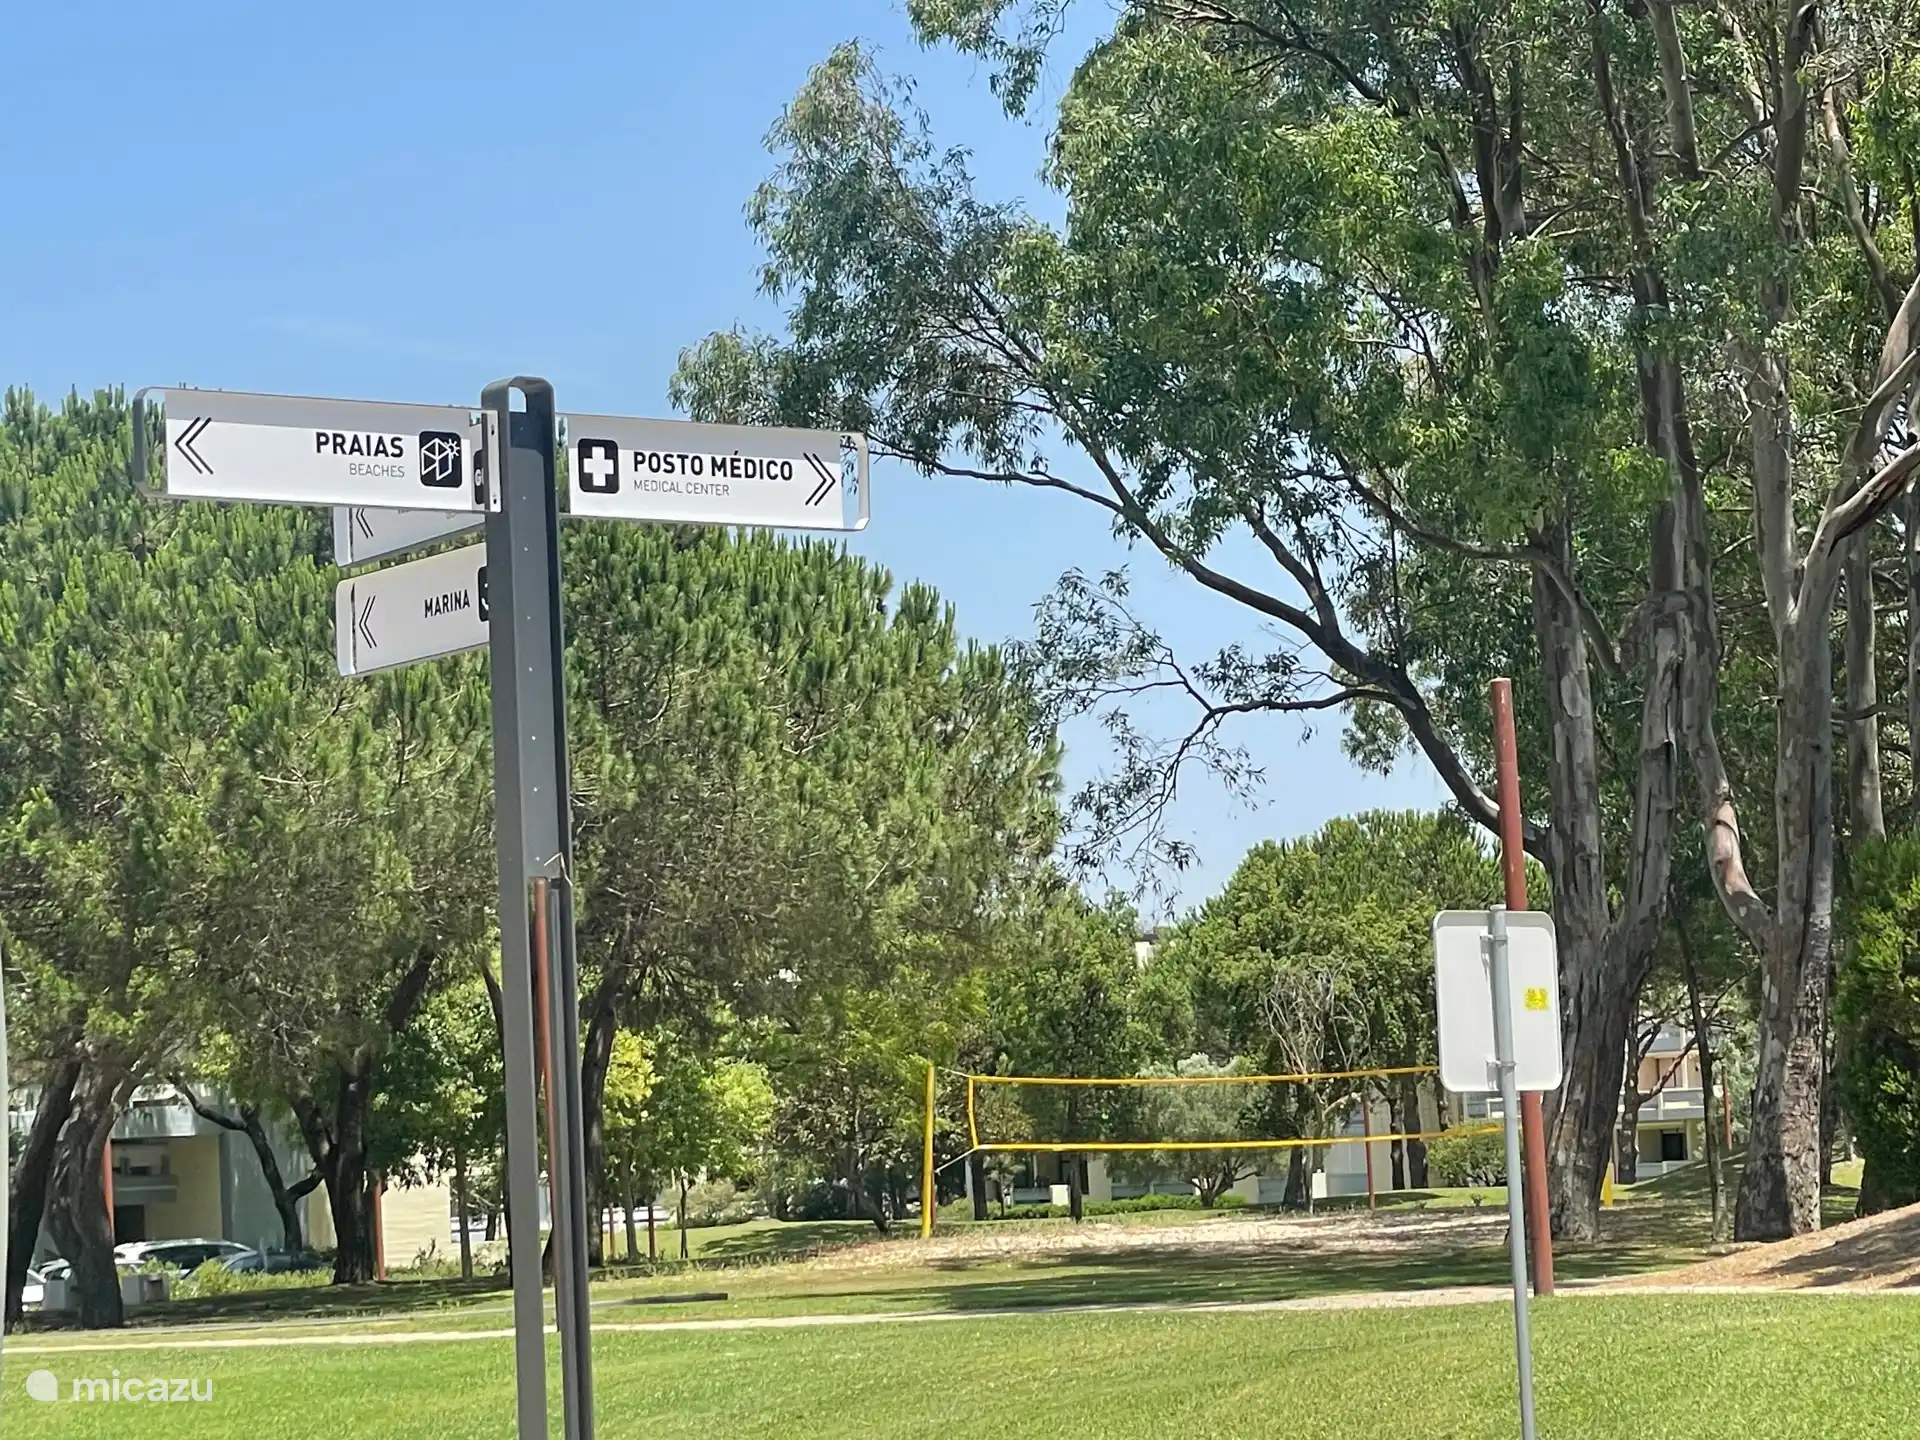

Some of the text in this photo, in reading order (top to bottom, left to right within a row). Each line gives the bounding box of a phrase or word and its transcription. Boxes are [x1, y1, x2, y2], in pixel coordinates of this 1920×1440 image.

[316, 431, 404, 458] PRAIAS
[349, 462, 405, 478] BEACHES
[633, 449, 793, 481] POSTO MÉDICO
[633, 479, 730, 497] MEDICAL CENTER
[424, 589, 470, 618] MARINA
